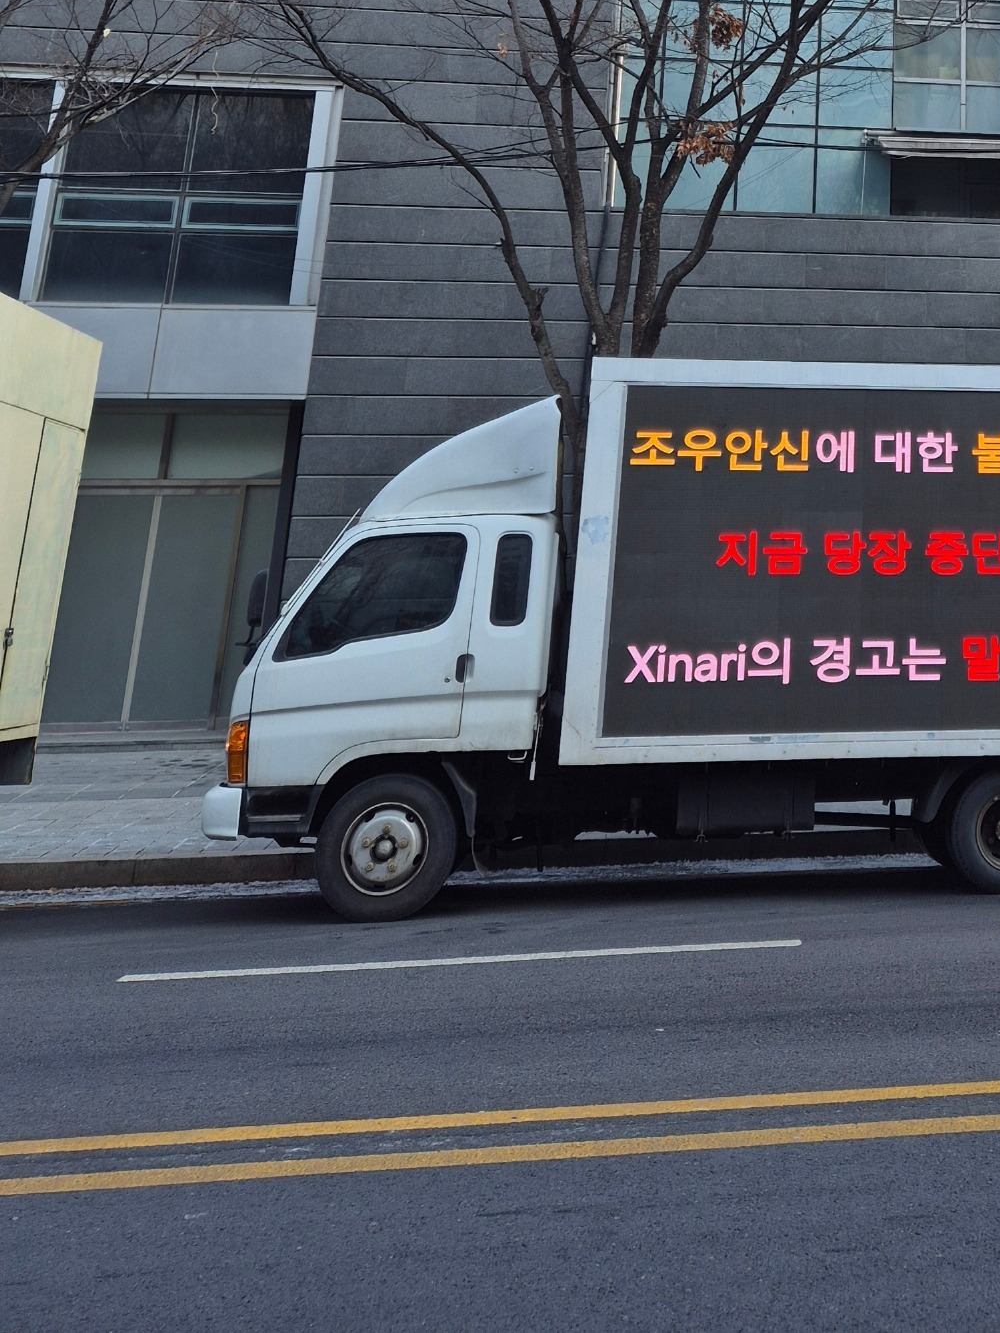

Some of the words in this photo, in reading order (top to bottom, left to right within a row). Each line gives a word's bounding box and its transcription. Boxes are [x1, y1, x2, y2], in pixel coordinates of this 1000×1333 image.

[629, 429, 856, 474] 조우안신에
[874, 431, 959, 474] 대한
[716, 530, 808, 576] 지금
[823, 530, 912, 576] 당장
[623, 637, 791, 685] Xinari의
[809, 635, 947, 684] 경고는
